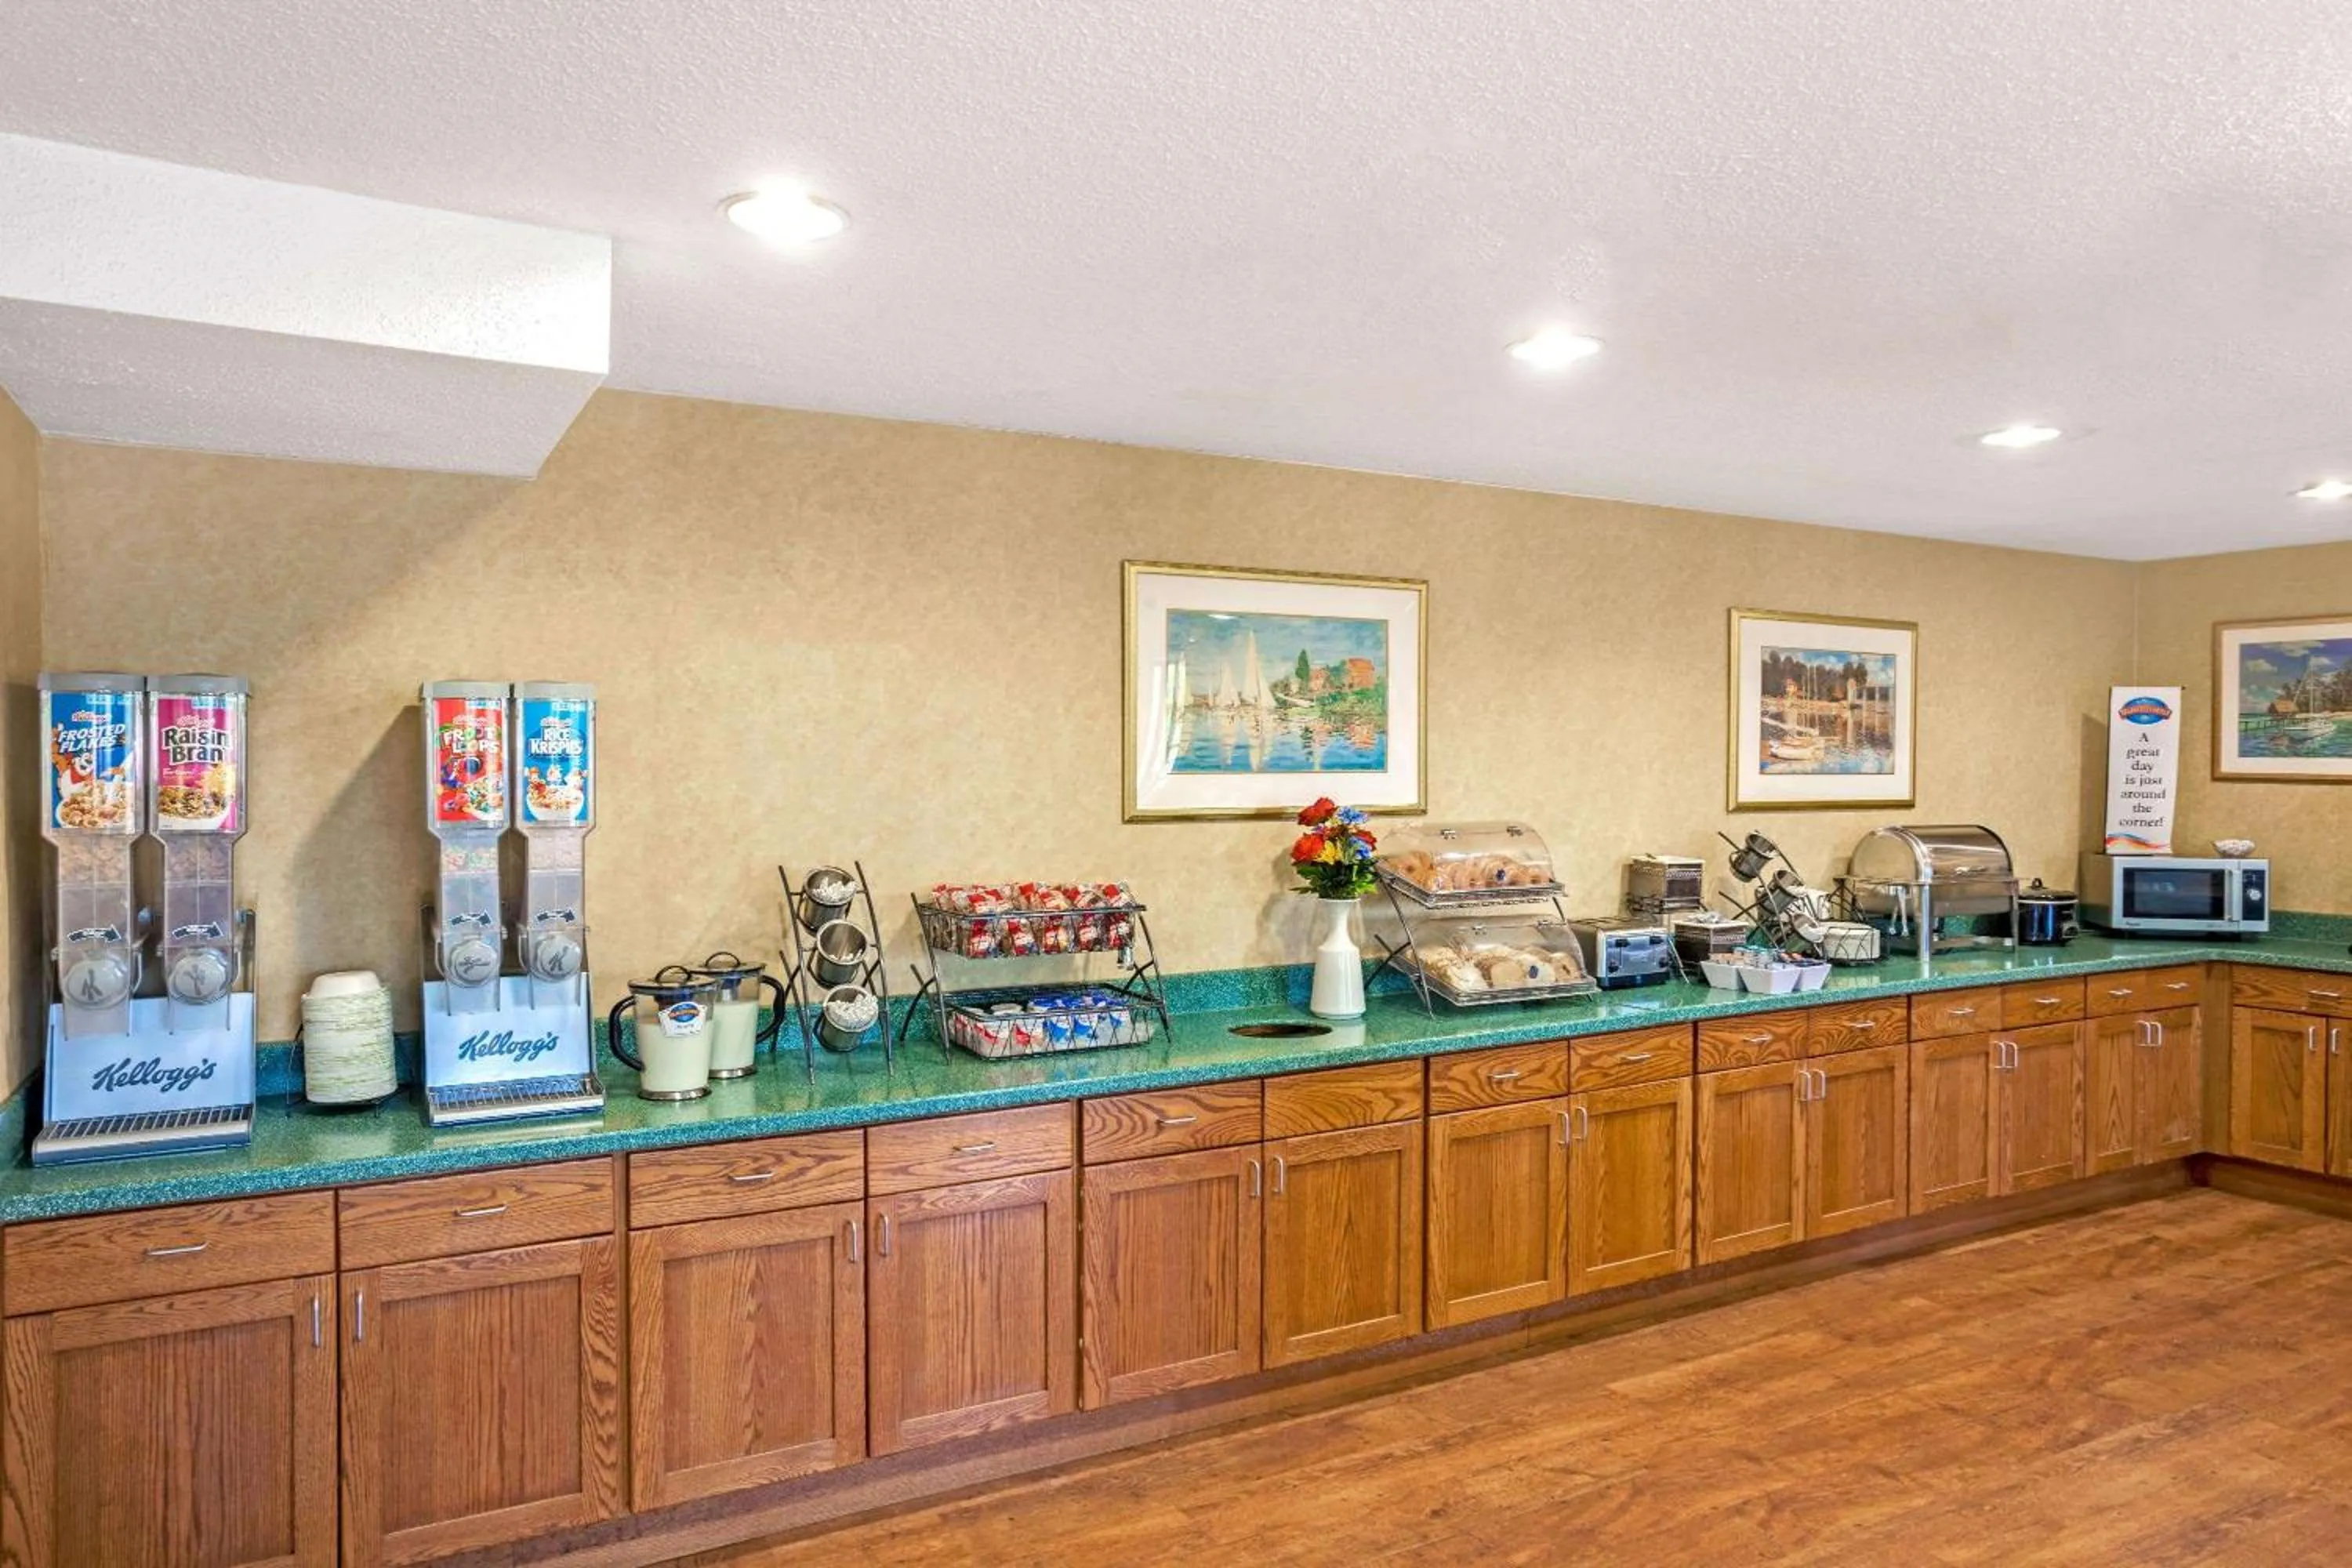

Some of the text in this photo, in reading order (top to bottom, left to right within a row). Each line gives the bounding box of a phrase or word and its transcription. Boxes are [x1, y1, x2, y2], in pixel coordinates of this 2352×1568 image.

[58, 724, 125, 742] FROSTED
[164, 728, 230, 746] Raisin
[543, 728, 571, 740] RICE
[2138, 732, 2149, 742] A
[60, 735, 118, 753] FLAKES
[529, 739, 583, 753] KRISPIES
[172, 746, 223, 762] Bran
[2125, 748, 2160, 759] great
[2130, 760, 2154, 773] day
[2125, 774, 2163, 787] is just
[2120, 789, 2165, 799] around
[2132, 802, 2152, 813] the
[2119, 817, 2164, 827] corner!
[459, 1030, 560, 1062] Kellogg's
[93, 1058, 217, 1093] Kellogg's
